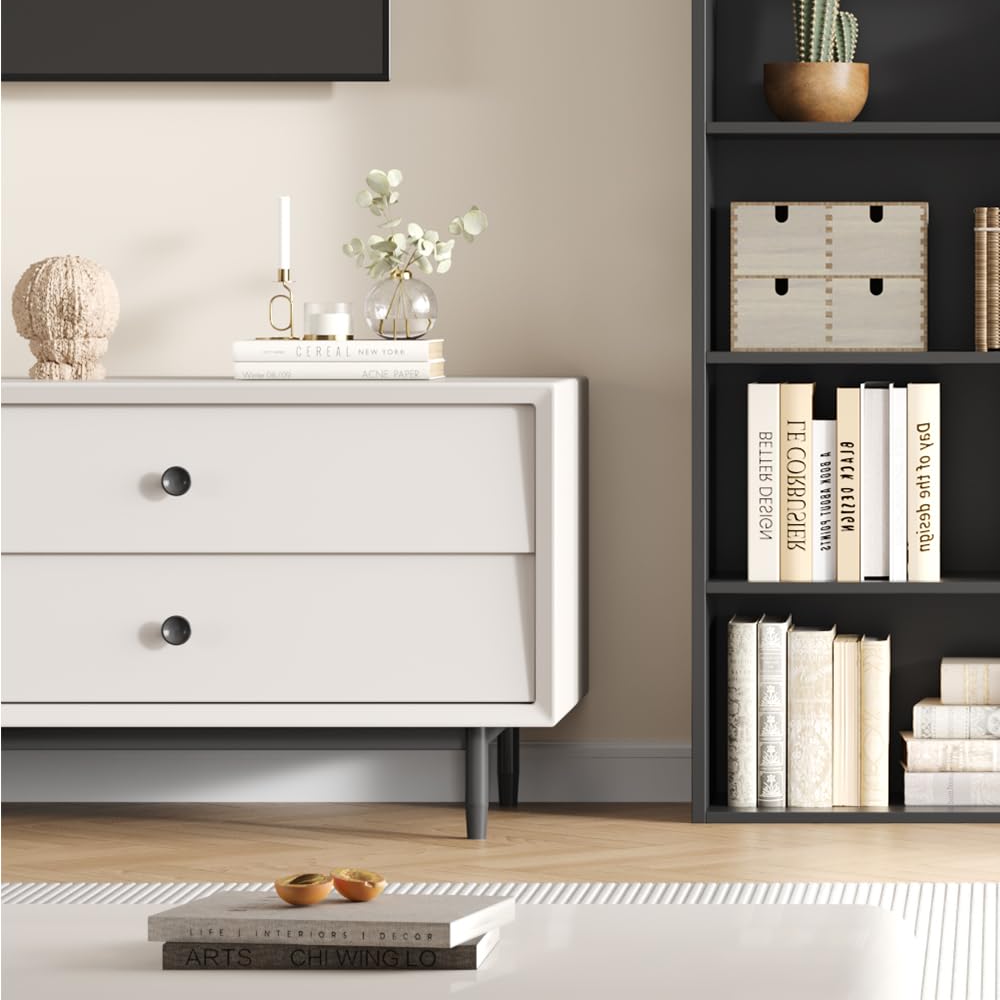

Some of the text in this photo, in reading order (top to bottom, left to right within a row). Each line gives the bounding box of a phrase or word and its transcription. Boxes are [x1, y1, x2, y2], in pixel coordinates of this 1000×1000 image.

[295, 345, 351, 358] CEREAL
[189, 927, 433, 941] LIFE INTERIORS DECOR
[185, 947, 437, 968] ARTS CHI WING LO
